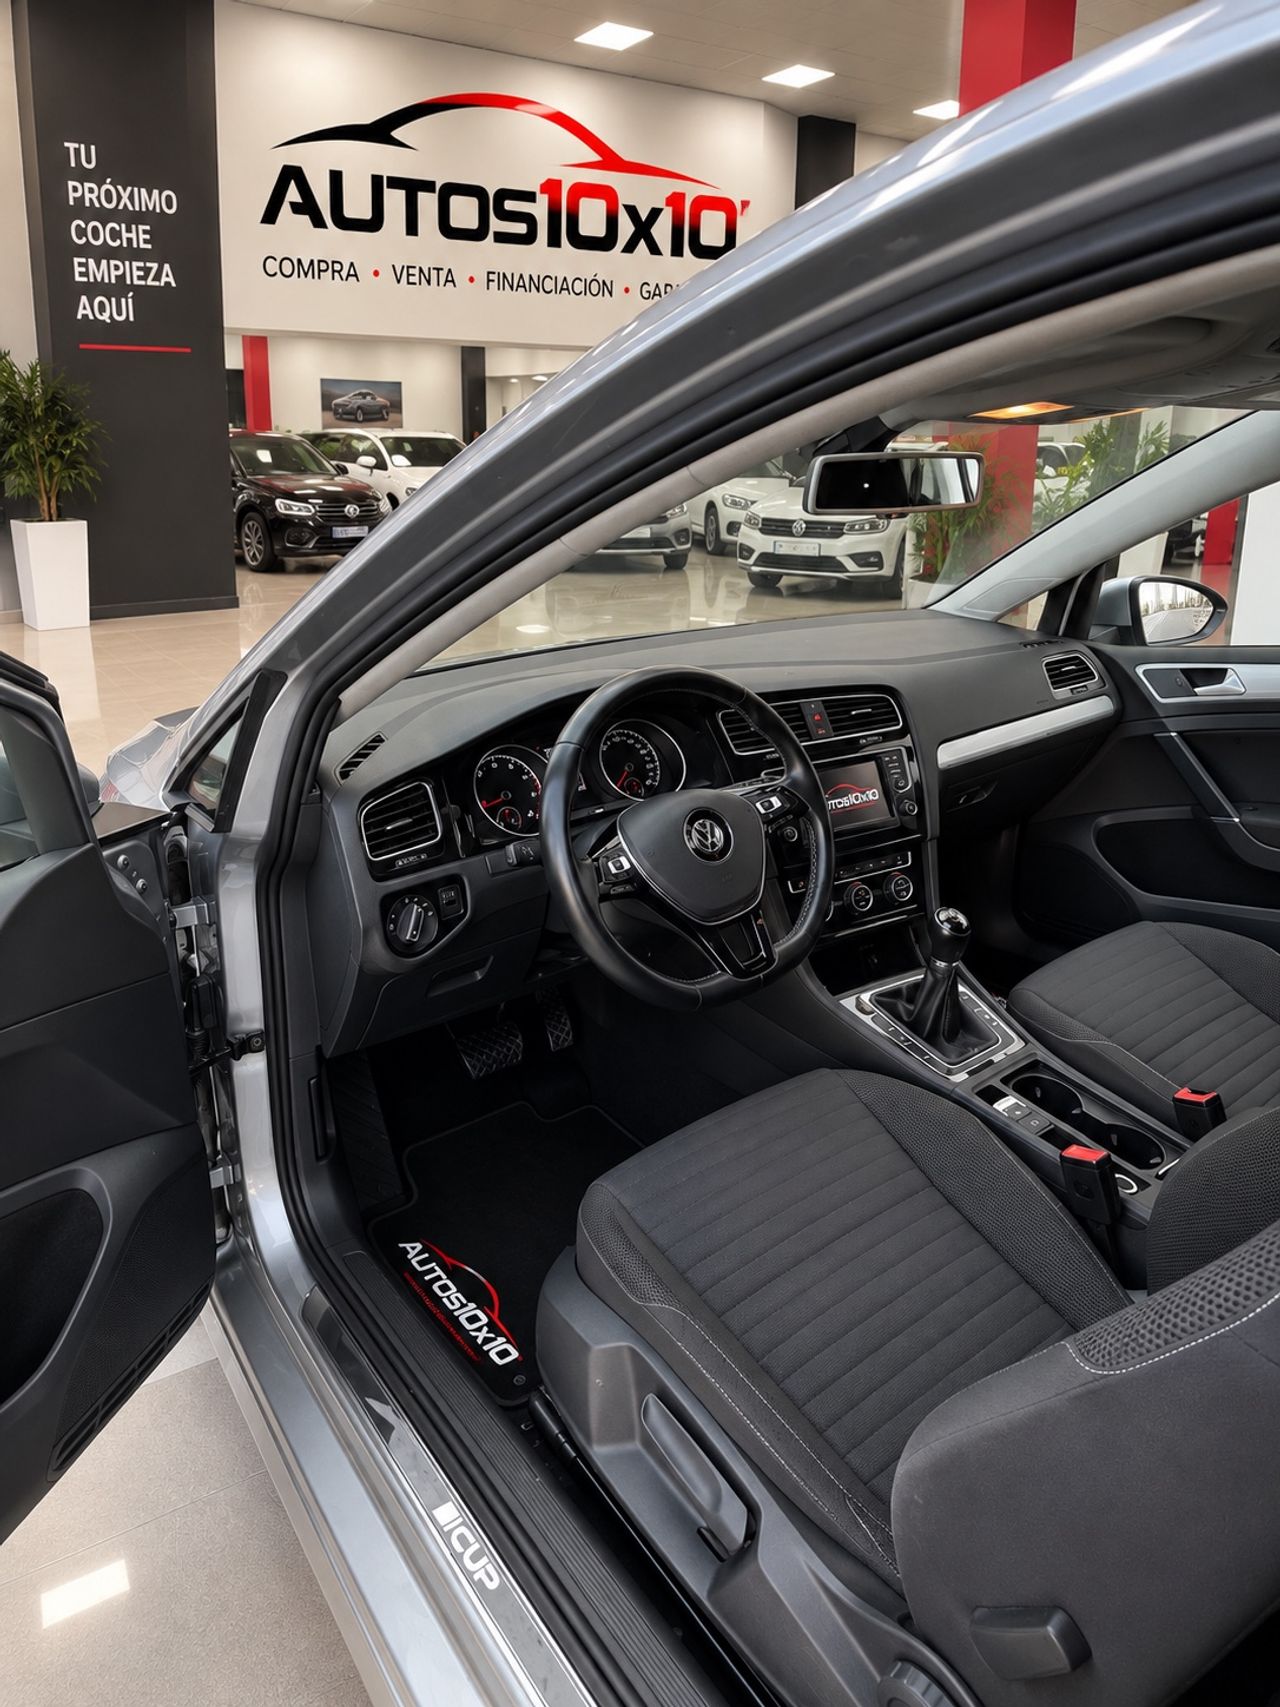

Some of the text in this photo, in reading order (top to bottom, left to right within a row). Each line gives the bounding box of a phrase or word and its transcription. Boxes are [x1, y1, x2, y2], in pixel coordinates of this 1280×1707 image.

[64, 142, 97, 169] TU
[67, 178, 177, 214] PRÓXIMO
[70, 220, 152, 249] COCHE
[73, 257, 177, 287] EMPIEZA
[262, 256, 360, 282] COMPRA
[392, 264, 457, 288] VENTA
[486, 271, 614, 298] FINANCIACIÓN
[76, 292, 135, 323] AQUÍ
[398, 1241, 520, 1366] AUTOS10x10
